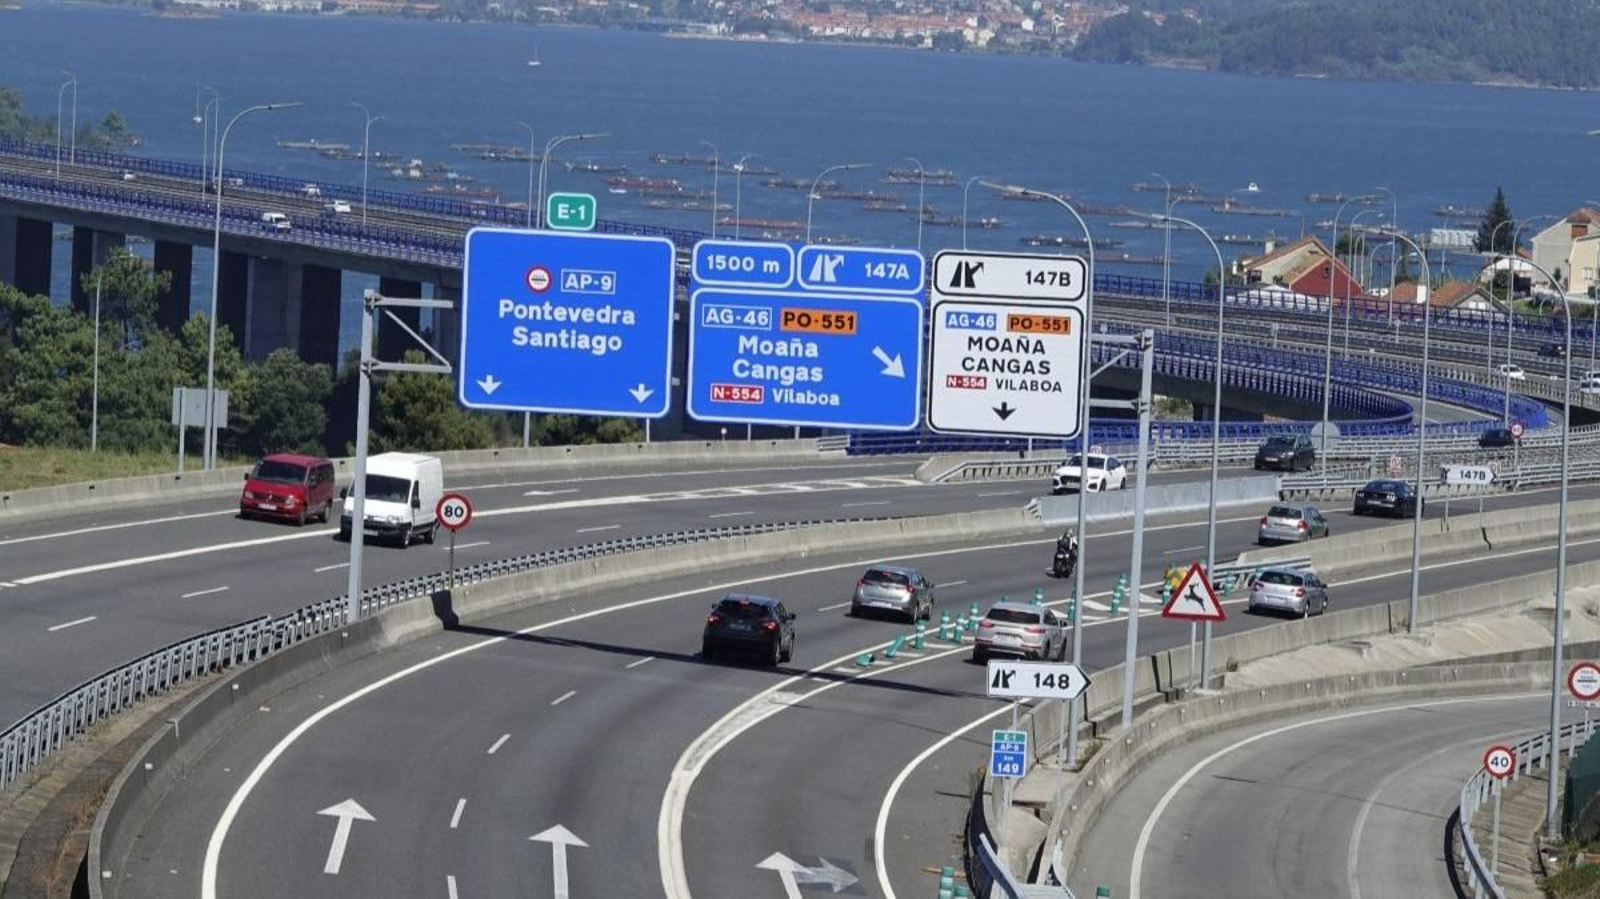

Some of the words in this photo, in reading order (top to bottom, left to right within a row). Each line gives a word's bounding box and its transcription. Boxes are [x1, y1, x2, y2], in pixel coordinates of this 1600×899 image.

[558, 204, 585, 220] E-1
[707, 255, 755, 271] 1500
[763, 259, 780, 273] m
[864, 263, 910, 280] 147A
[565, 273, 613, 291] AP-9
[1025, 270, 1071, 287] 147B
[498, 299, 636, 325] Pontevedra
[705, 308, 769, 326] AG-46
[783, 311, 855, 331] PO-551
[948, 314, 995, 328] AG-46
[1010, 317, 1069, 331] PO-551
[512, 327, 622, 356] Santiago
[738, 335, 819, 358] Moaña
[967, 336, 1046, 354] MOAÑA
[732, 359, 824, 385] Cangas
[961, 357, 1051, 375] CANGAS
[947, 376, 986, 388] N-554
[995, 378, 1062, 393] VILABOA
[713, 387, 761, 401] N-554
[772, 388, 840, 406] Vilaboa
[444, 505, 464, 518] 80
[1033, 673, 1070, 690] 148
[997, 762, 1020, 774] 149
[1490, 756, 1509, 767] 40
